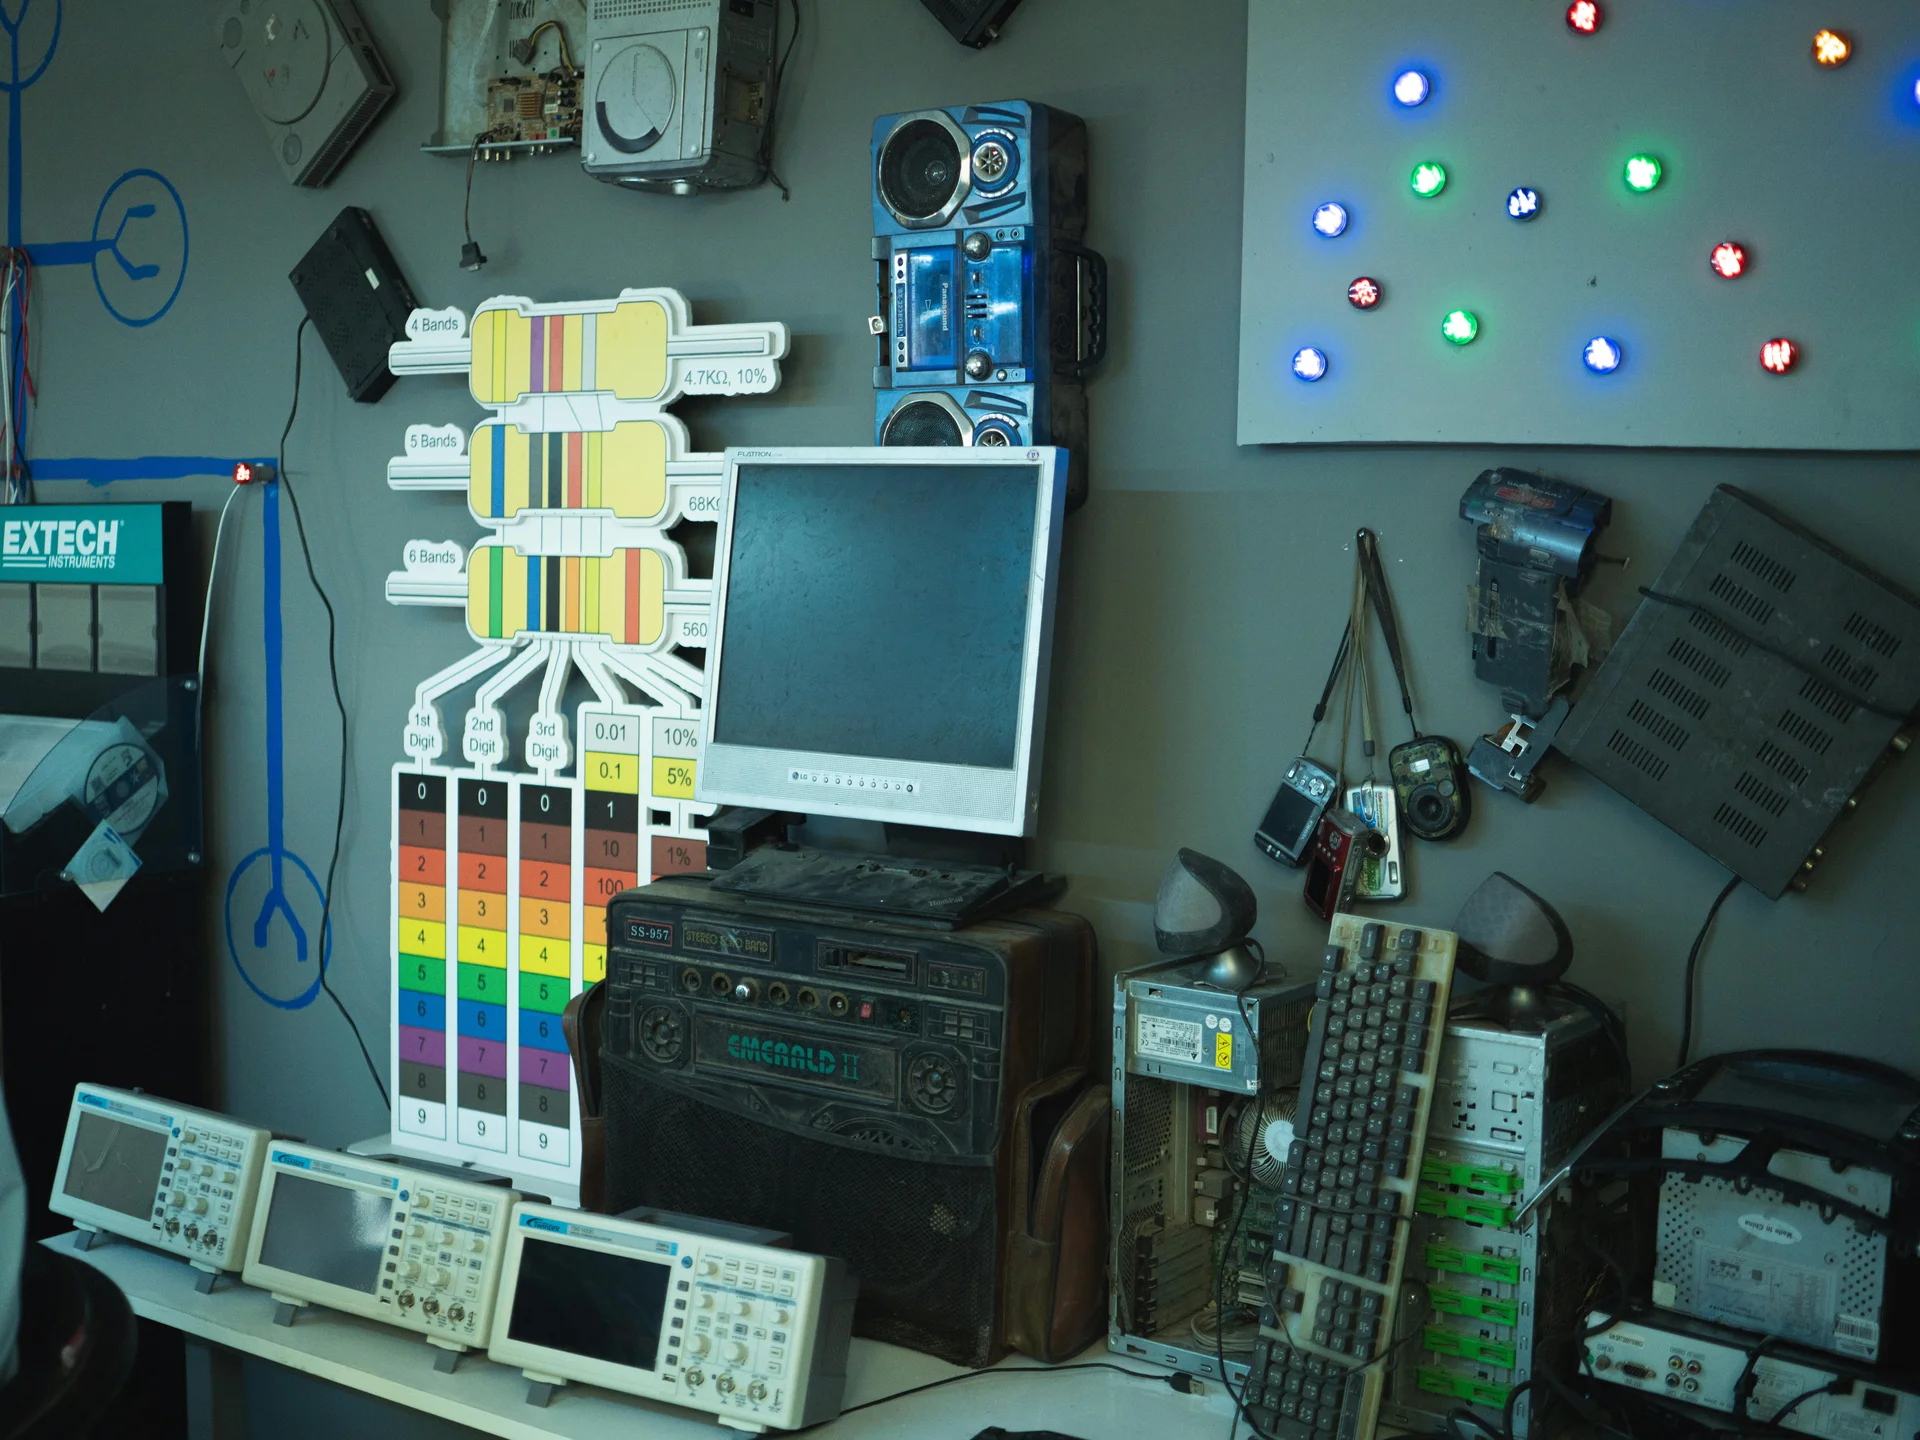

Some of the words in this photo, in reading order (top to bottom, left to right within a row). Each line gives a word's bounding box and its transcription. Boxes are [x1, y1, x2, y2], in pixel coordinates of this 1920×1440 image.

[411, 318, 419, 332] 4
[421, 317, 459, 332] Bands
[737, 368, 768, 385] 10%
[410, 434, 418, 449] 5
[421, 434, 457, 449] Bands
[737, 450, 772, 458] FLATRON
[3, 519, 119, 555] EXTECH
[48, 555, 115, 569] INSTRUMENTS
[409, 550, 417, 564] 6
[419, 549, 456, 564] Bands
[414, 714, 431, 727] 1st
[472, 718, 494, 732] 2nd
[536, 723, 555, 737] 3rd
[595, 724, 627, 742] 0.01
[664, 728, 698, 748] 10%
[409, 734, 435, 750] Digit
[469, 739, 496, 755] Digit
[532, 743, 560, 760] Digit
[599, 762, 622, 780] 0.1
[667, 767, 692, 787] 5%
[799, 773, 808, 781] LG
[417, 782, 426, 800] 0
[478, 788, 487, 806] 0
[540, 794, 550, 812] 0
[607, 801, 614, 819] 1
[419, 819, 425, 835] 1
[479, 827, 485, 842] 1
[541, 833, 548, 849] 1
[603, 839, 620, 857] 10
[417, 856, 426, 873] 2
[668, 847, 691, 867] 1%
[478, 863, 487, 880] 2
[540, 871, 549, 887] 2
[598, 877, 624, 895] 100
[417, 892, 426, 909] 3
[478, 900, 487, 917] 3
[540, 908, 549, 926] 3
[417, 929, 426, 944] 4
[631, 925, 669, 941] SS-957
[477, 937, 486, 953] 4
[686, 930, 718, 945] STEREO
[745, 939, 769, 953] BAND
[539, 946, 548, 963] 4
[417, 965, 426, 981] 5
[477, 974, 486, 990] 5
[539, 984, 549, 1000] 5
[417, 1001, 426, 1017] 6
[477, 1011, 486, 1027] 6
[539, 1021, 549, 1038] 6
[418, 1036, 426, 1052] 7
[477, 1047, 486, 1063] 7
[728, 1034, 836, 1075] EMERALD
[539, 1058, 548, 1075] 7
[418, 1073, 426, 1089] 8
[477, 1083, 486, 1100] 8
[539, 1096, 548, 1113] 8
[418, 1109, 426, 1125] 9
[477, 1121, 486, 1136] 9
[539, 1133, 548, 1150] 9
[1744, 1220, 1764, 1231] China
[1774, 1228, 1793, 1239] Made
